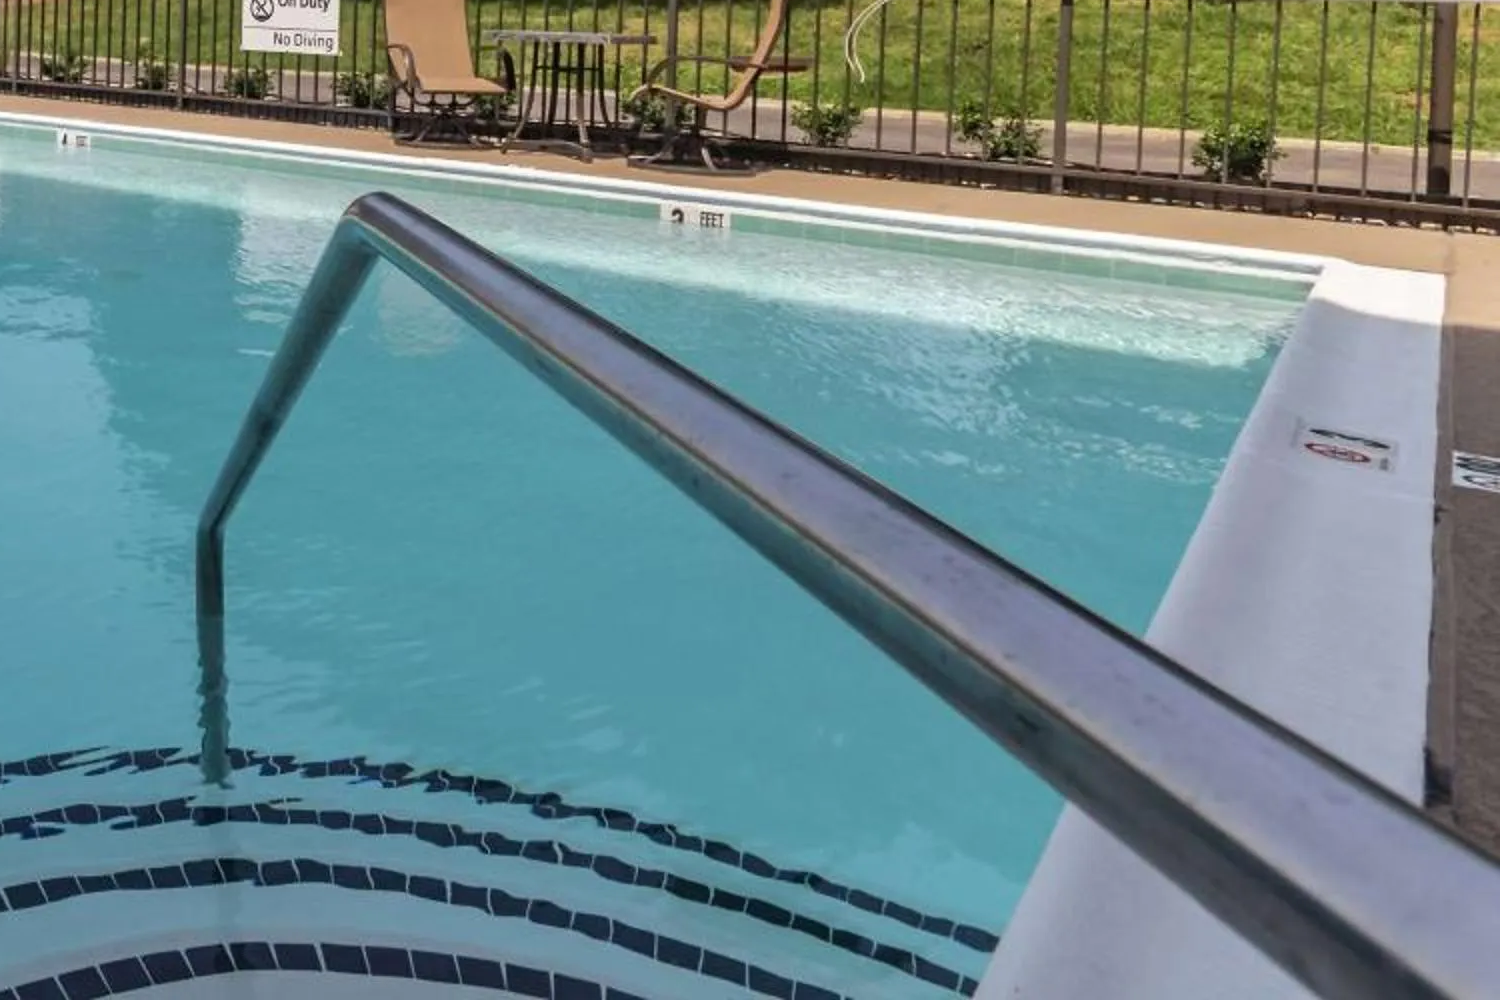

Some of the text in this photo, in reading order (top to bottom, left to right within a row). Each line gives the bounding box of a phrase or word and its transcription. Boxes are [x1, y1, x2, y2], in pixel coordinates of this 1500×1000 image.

[273, 32, 334, 53] No Diving
[700, 211, 724, 228] FEET
